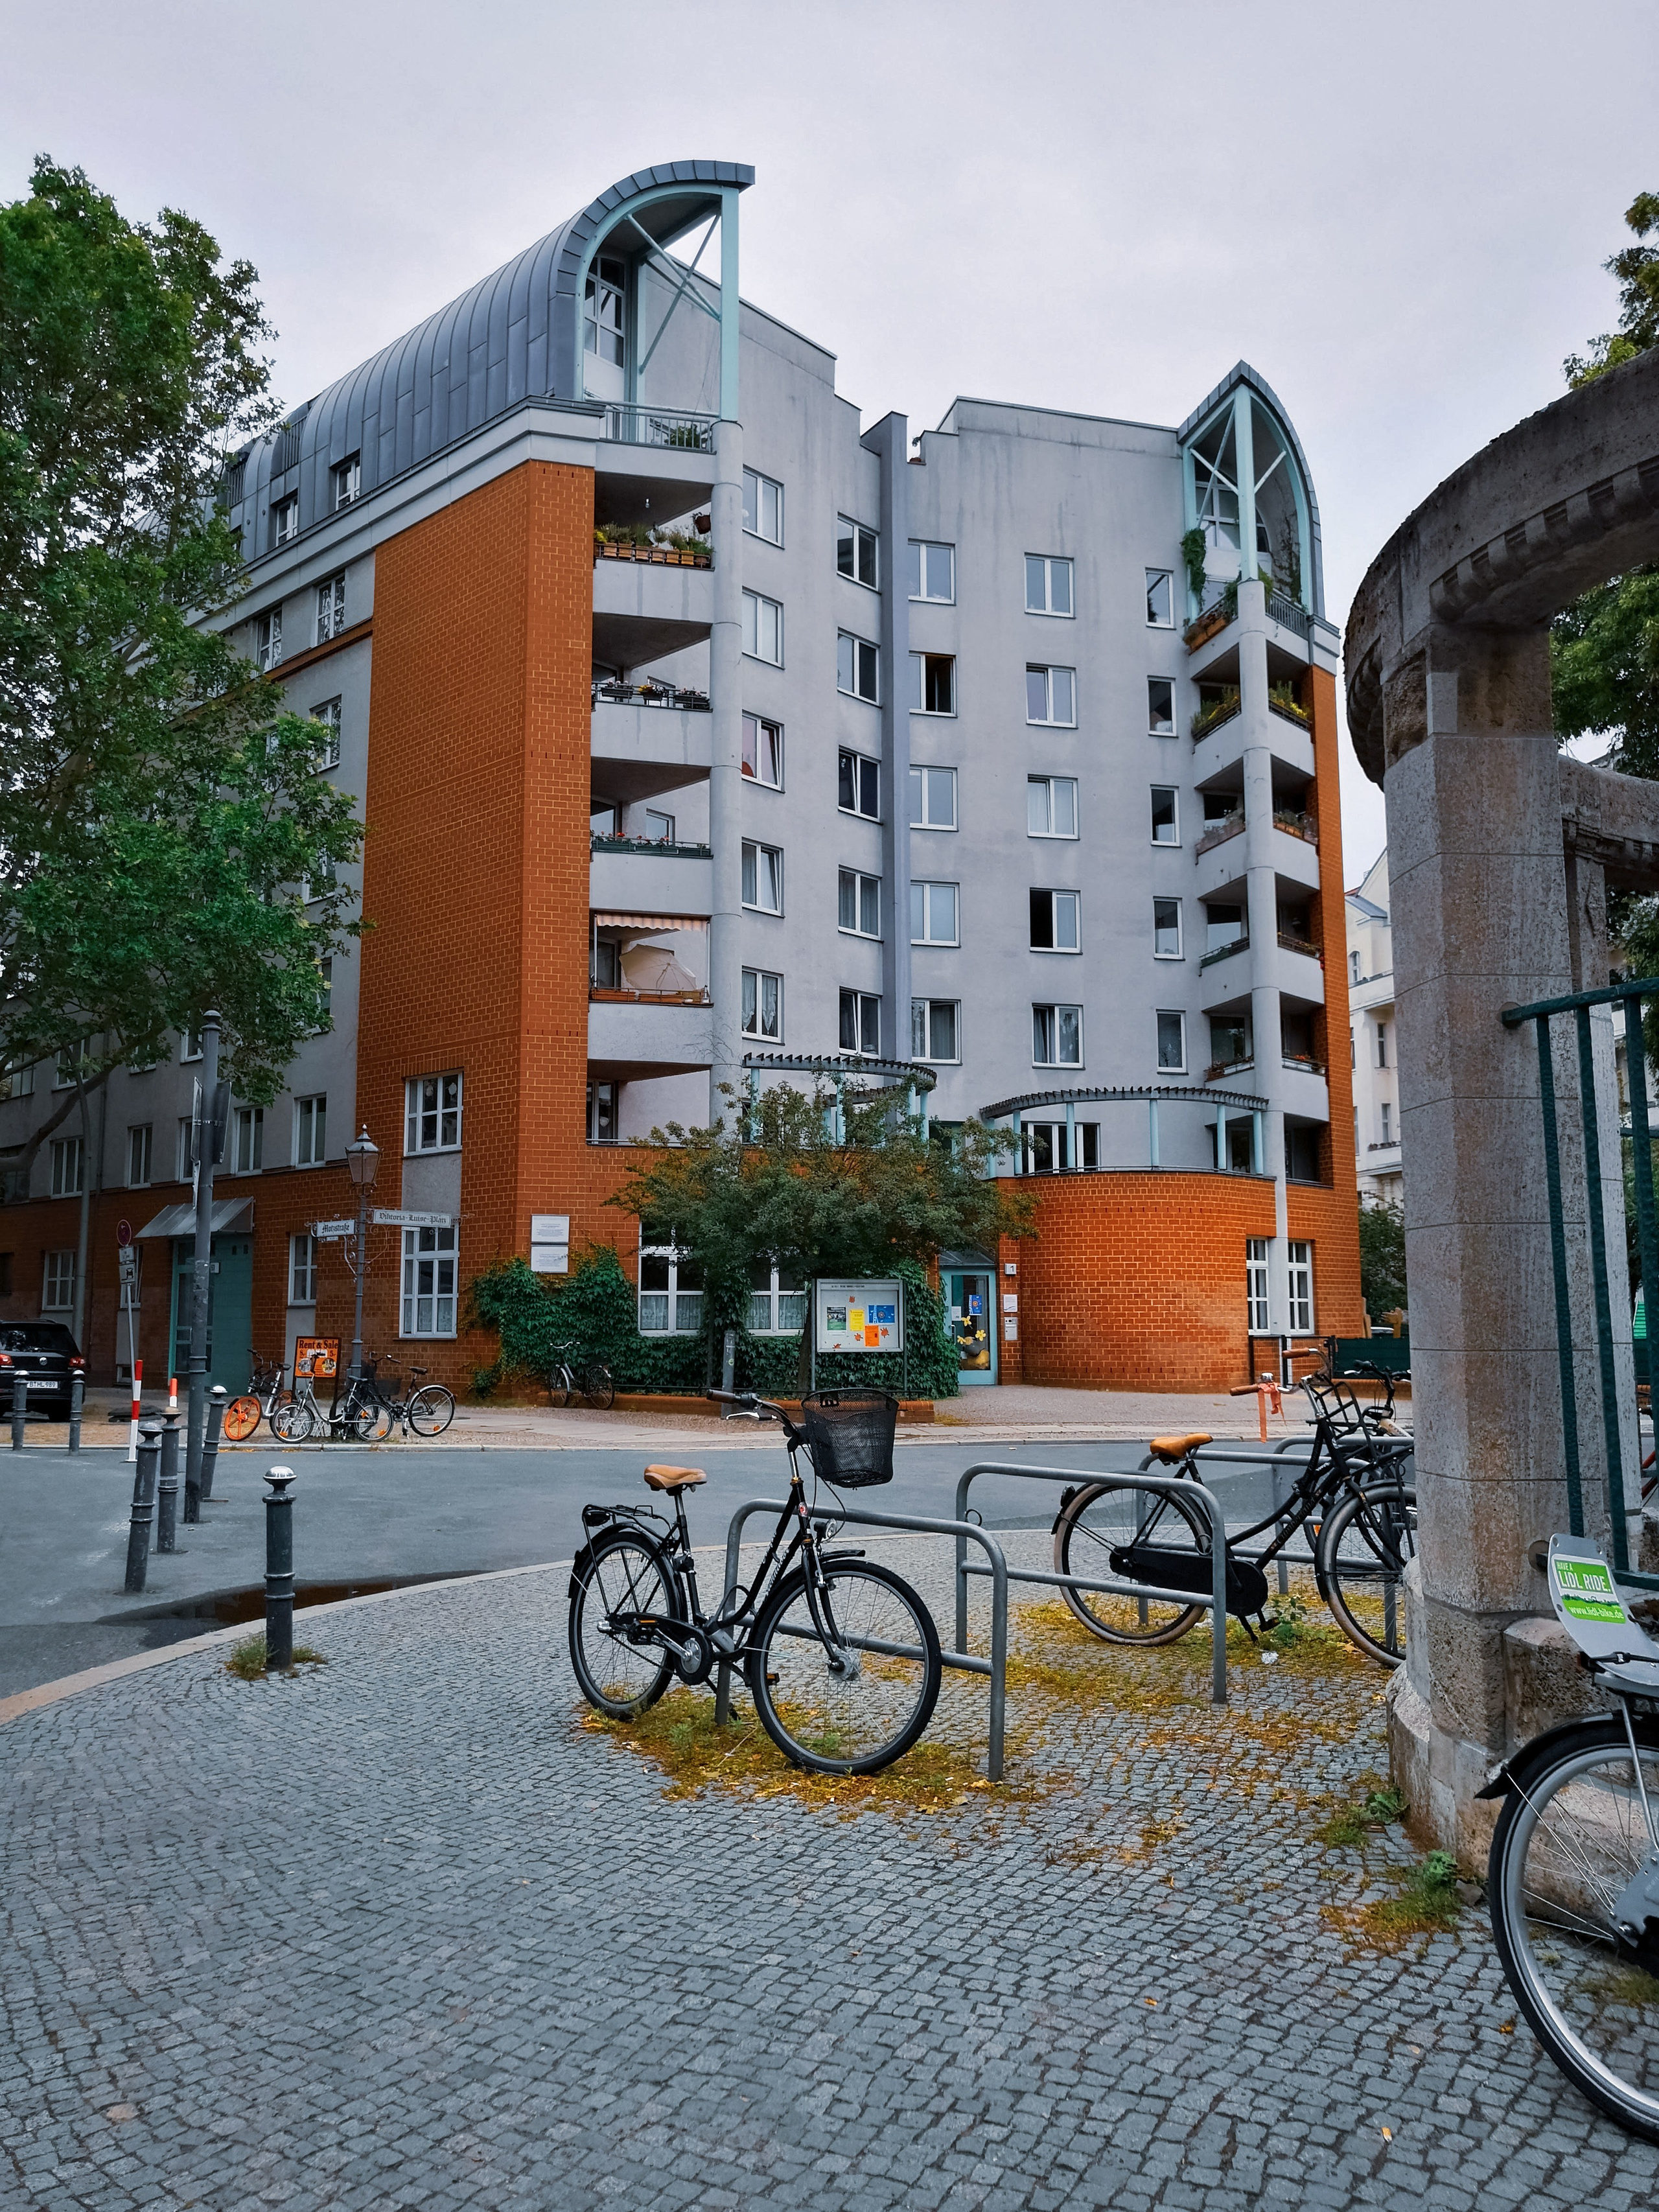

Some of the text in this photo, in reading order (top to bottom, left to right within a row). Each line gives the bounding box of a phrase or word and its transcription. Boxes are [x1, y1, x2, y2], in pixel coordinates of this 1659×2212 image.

[378, 1212, 447, 1224] Viktoria-Luise-Platz
[321, 1223, 350, 1234] Motzstraße
[299, 1340, 315, 1349] Rent
[323, 1340, 338, 1349] Sale
[1557, 1561, 1568, 1570] HAVE
[1558, 1570, 1611, 1592] LIDL RIDE.
[1568, 1607, 1624, 1619] www.lidl-bike.de
